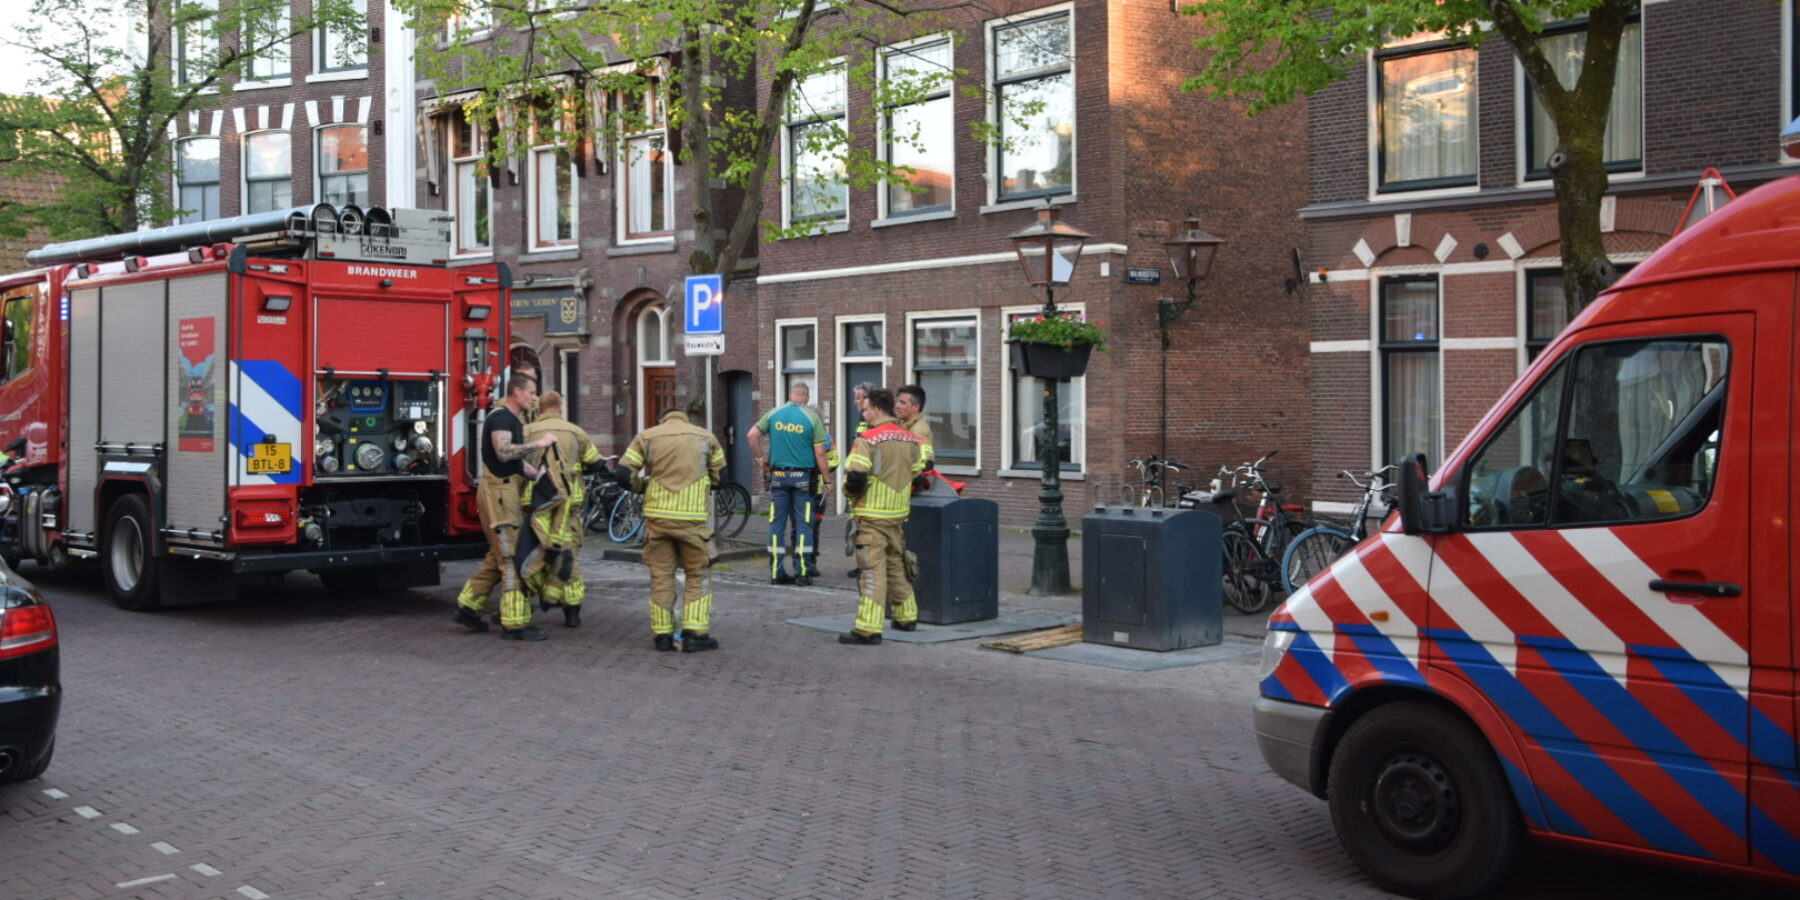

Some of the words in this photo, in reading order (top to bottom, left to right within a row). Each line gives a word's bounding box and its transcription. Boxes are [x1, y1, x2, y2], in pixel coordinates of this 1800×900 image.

[347, 265, 418, 279] BRANDWEER
[693, 283, 712, 327] P
[775, 421, 804, 434] OvDG
[265, 445, 277, 456] 15
[253, 459, 285, 470] BTL-8
